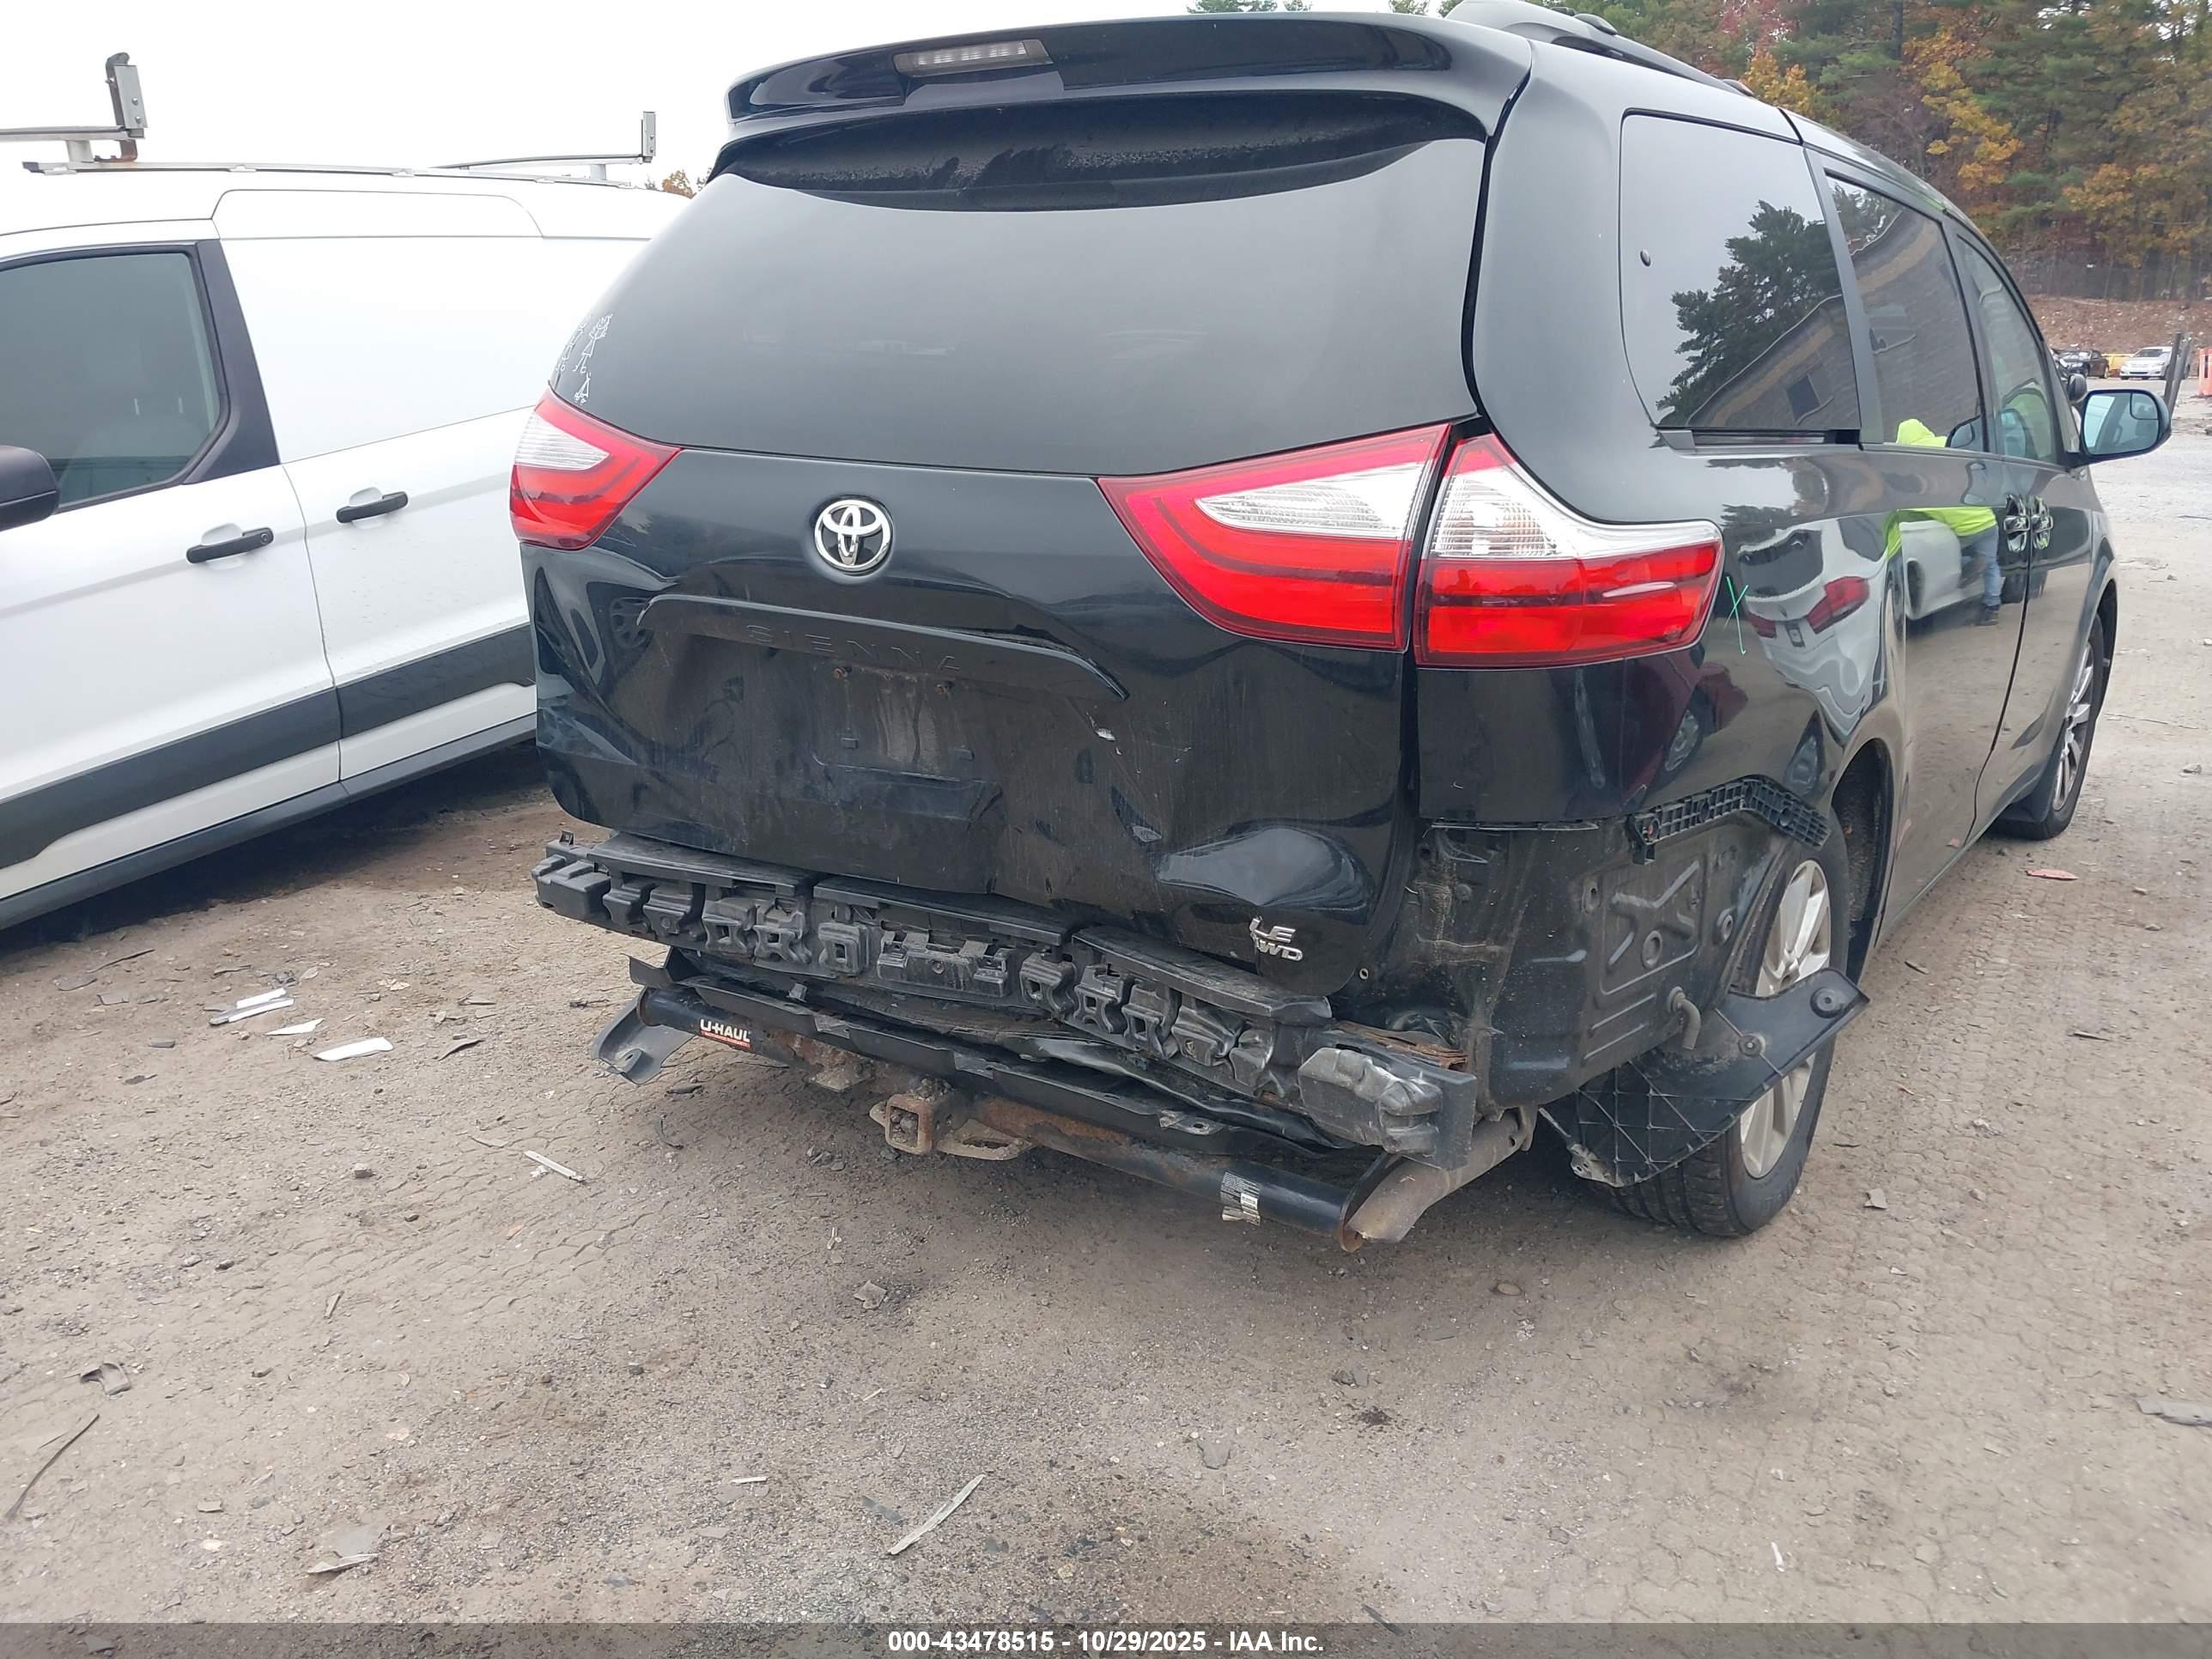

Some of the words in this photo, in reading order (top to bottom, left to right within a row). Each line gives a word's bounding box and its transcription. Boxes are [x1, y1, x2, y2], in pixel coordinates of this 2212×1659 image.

[745, 624, 960, 671] SIENNA
[1249, 917, 1296, 944] LE
[700, 1018, 750, 1043] U-HAUL
